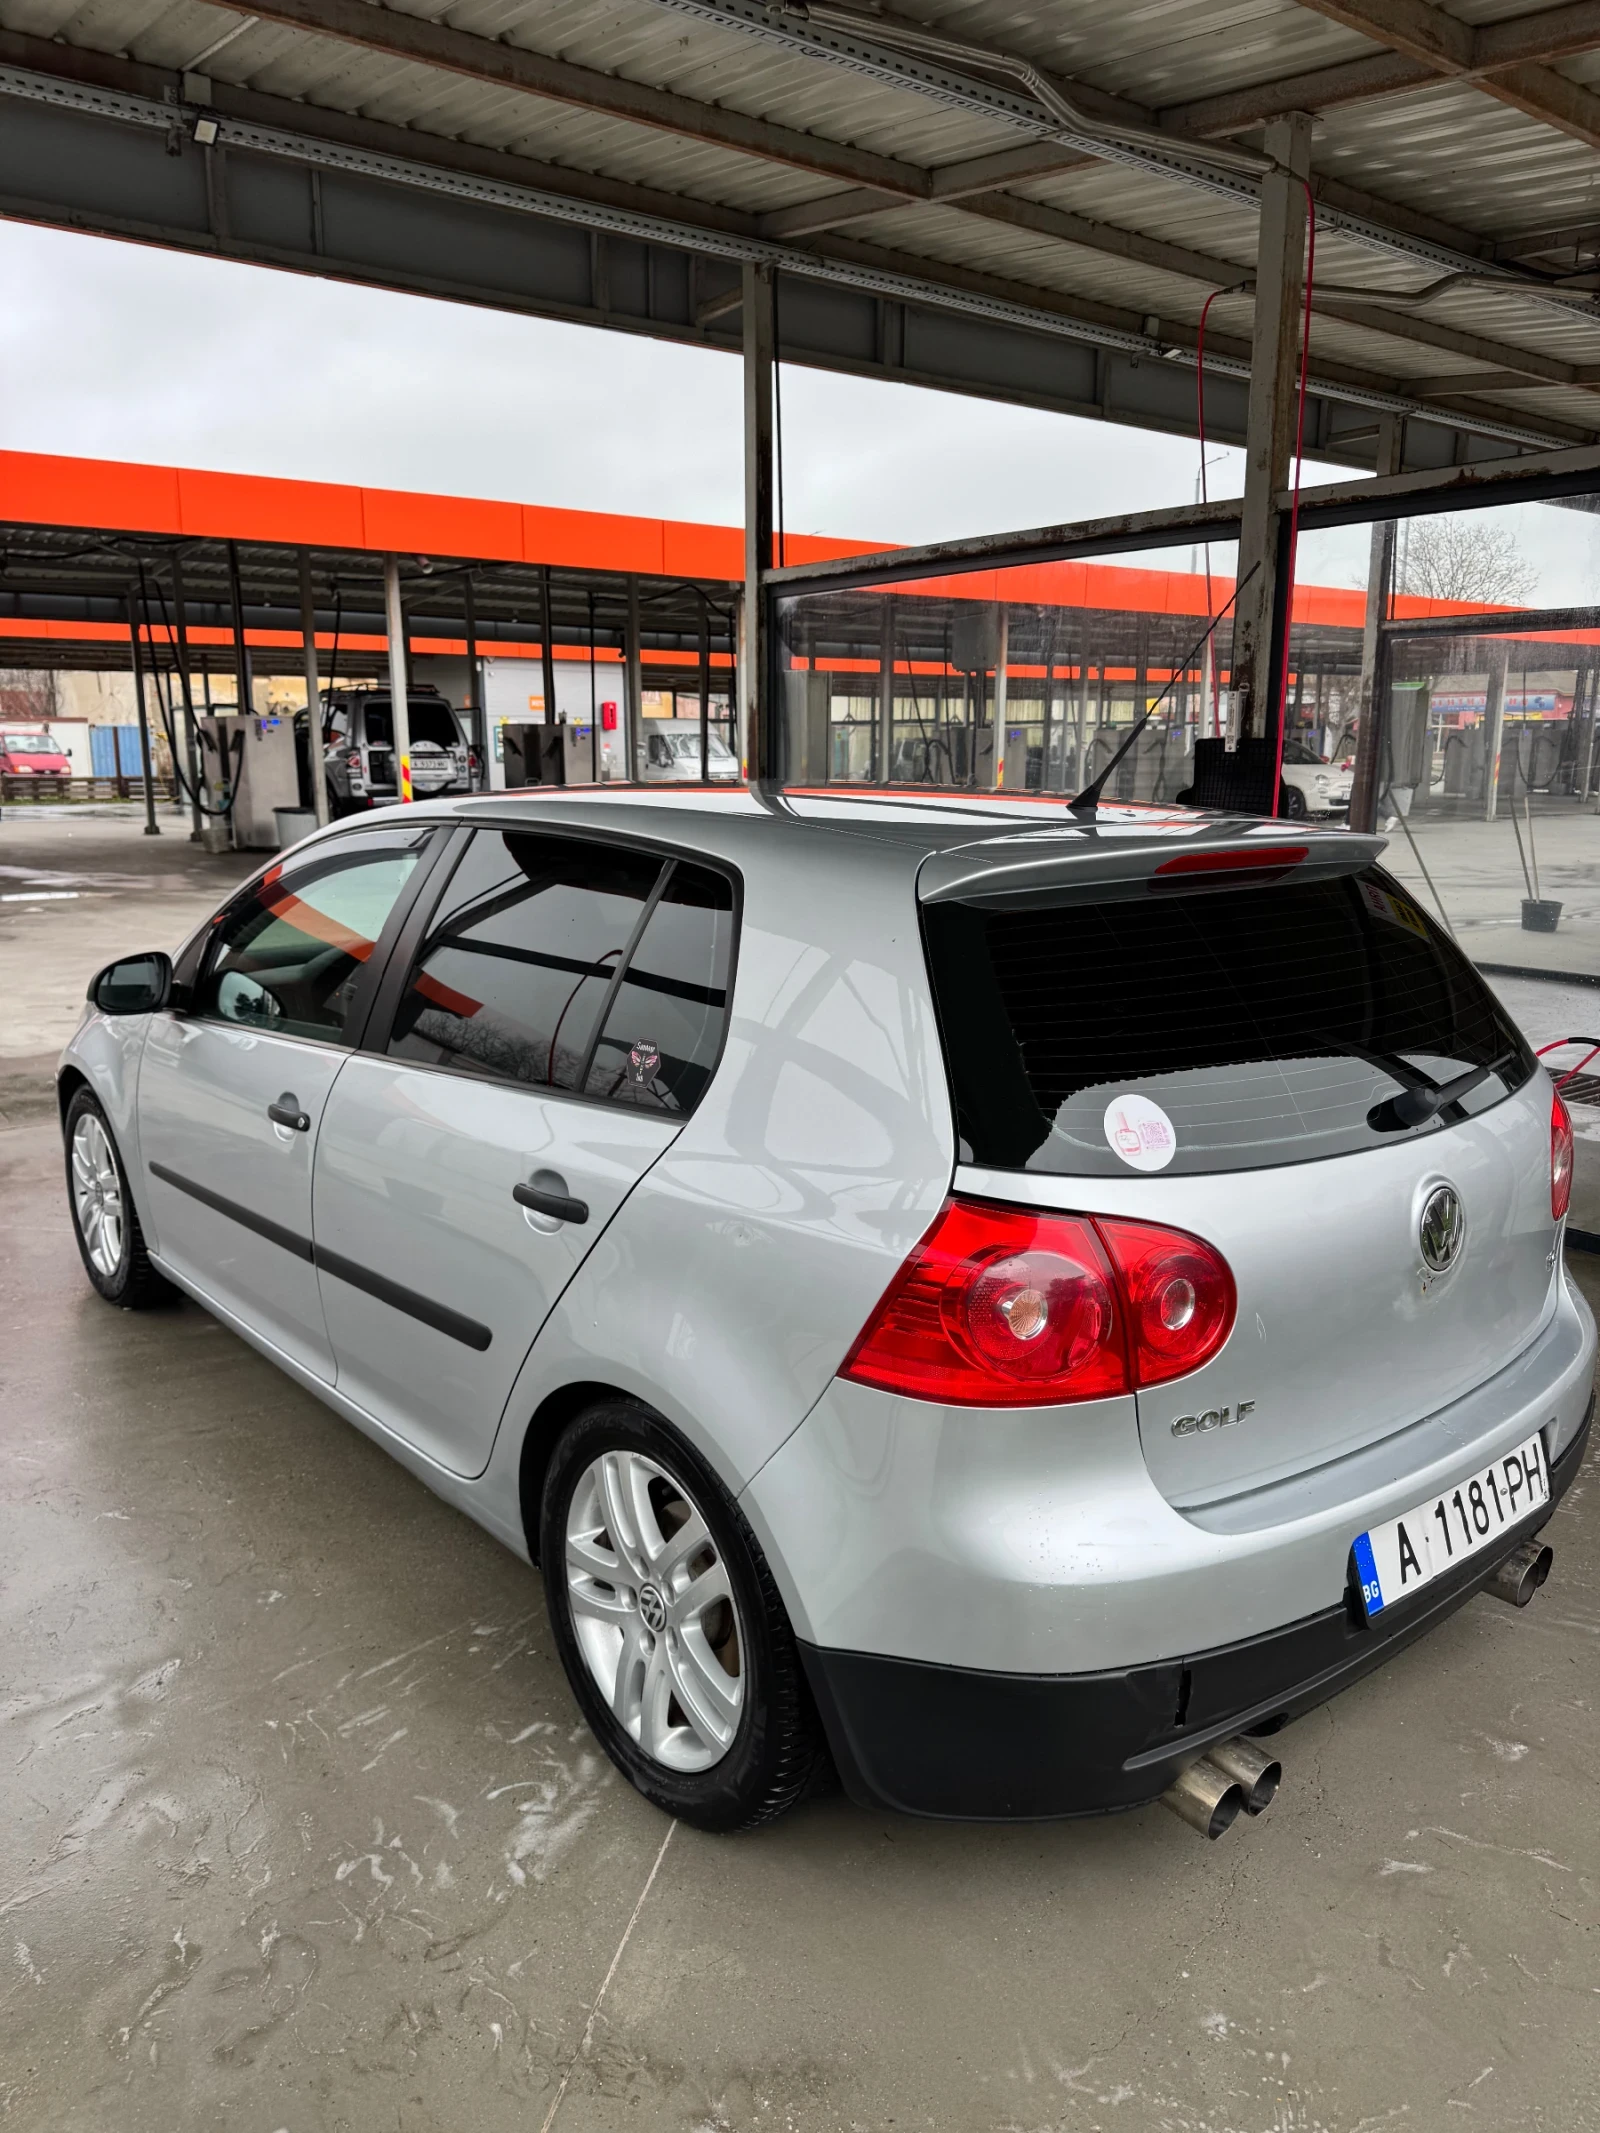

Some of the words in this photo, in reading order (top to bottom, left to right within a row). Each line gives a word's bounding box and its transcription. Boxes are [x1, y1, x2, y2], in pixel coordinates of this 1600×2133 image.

[1171, 1399, 1256, 1438] GOLF
[1396, 1521, 1422, 1585] A
[1362, 1580, 1380, 1603] BG
